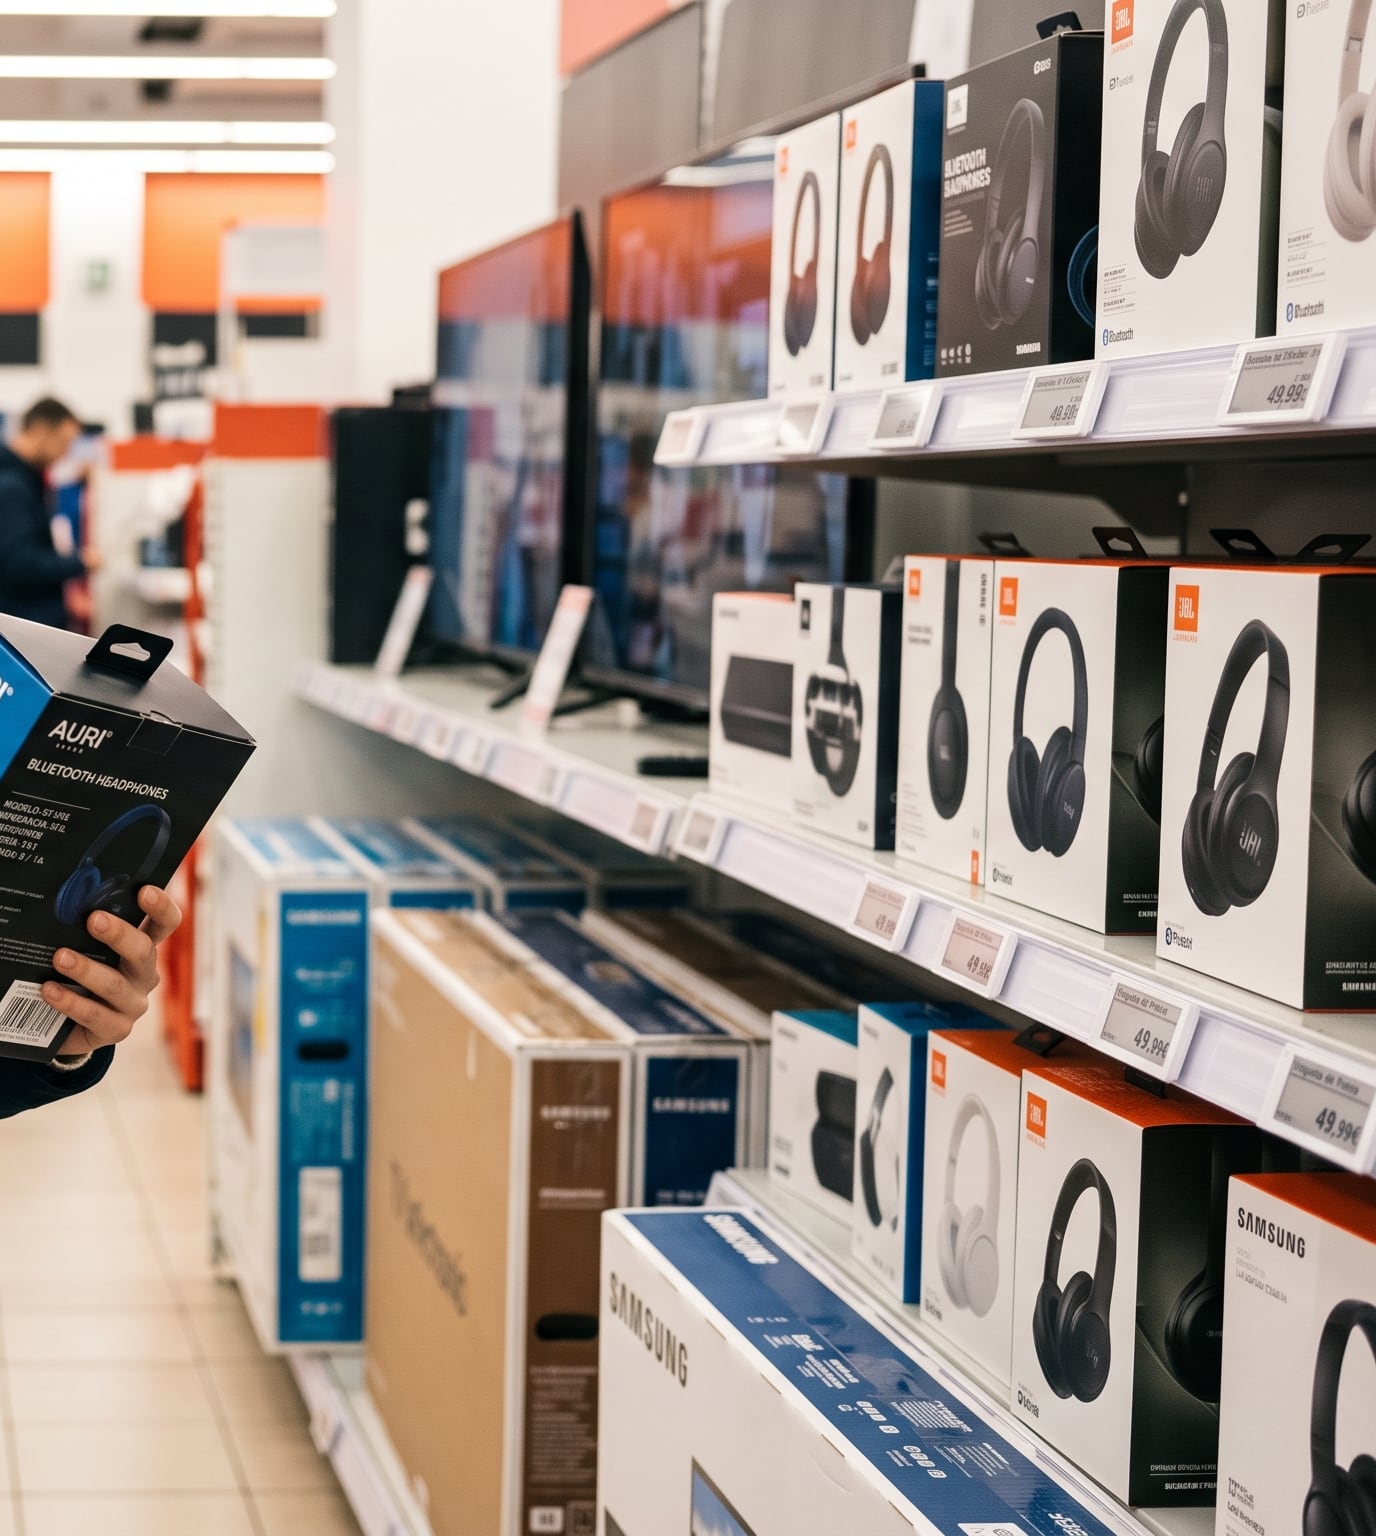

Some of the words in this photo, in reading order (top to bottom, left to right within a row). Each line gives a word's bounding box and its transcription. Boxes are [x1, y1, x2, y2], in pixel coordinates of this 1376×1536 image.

[1178, 596, 1195, 619] JBL
[26, 757, 97, 785] BLUETOOTH
[94, 774, 170, 801] HEADPHONES
[1237, 1206, 1306, 1260] SAMSUNG
[608, 1270, 689, 1390] SAMSUNG
